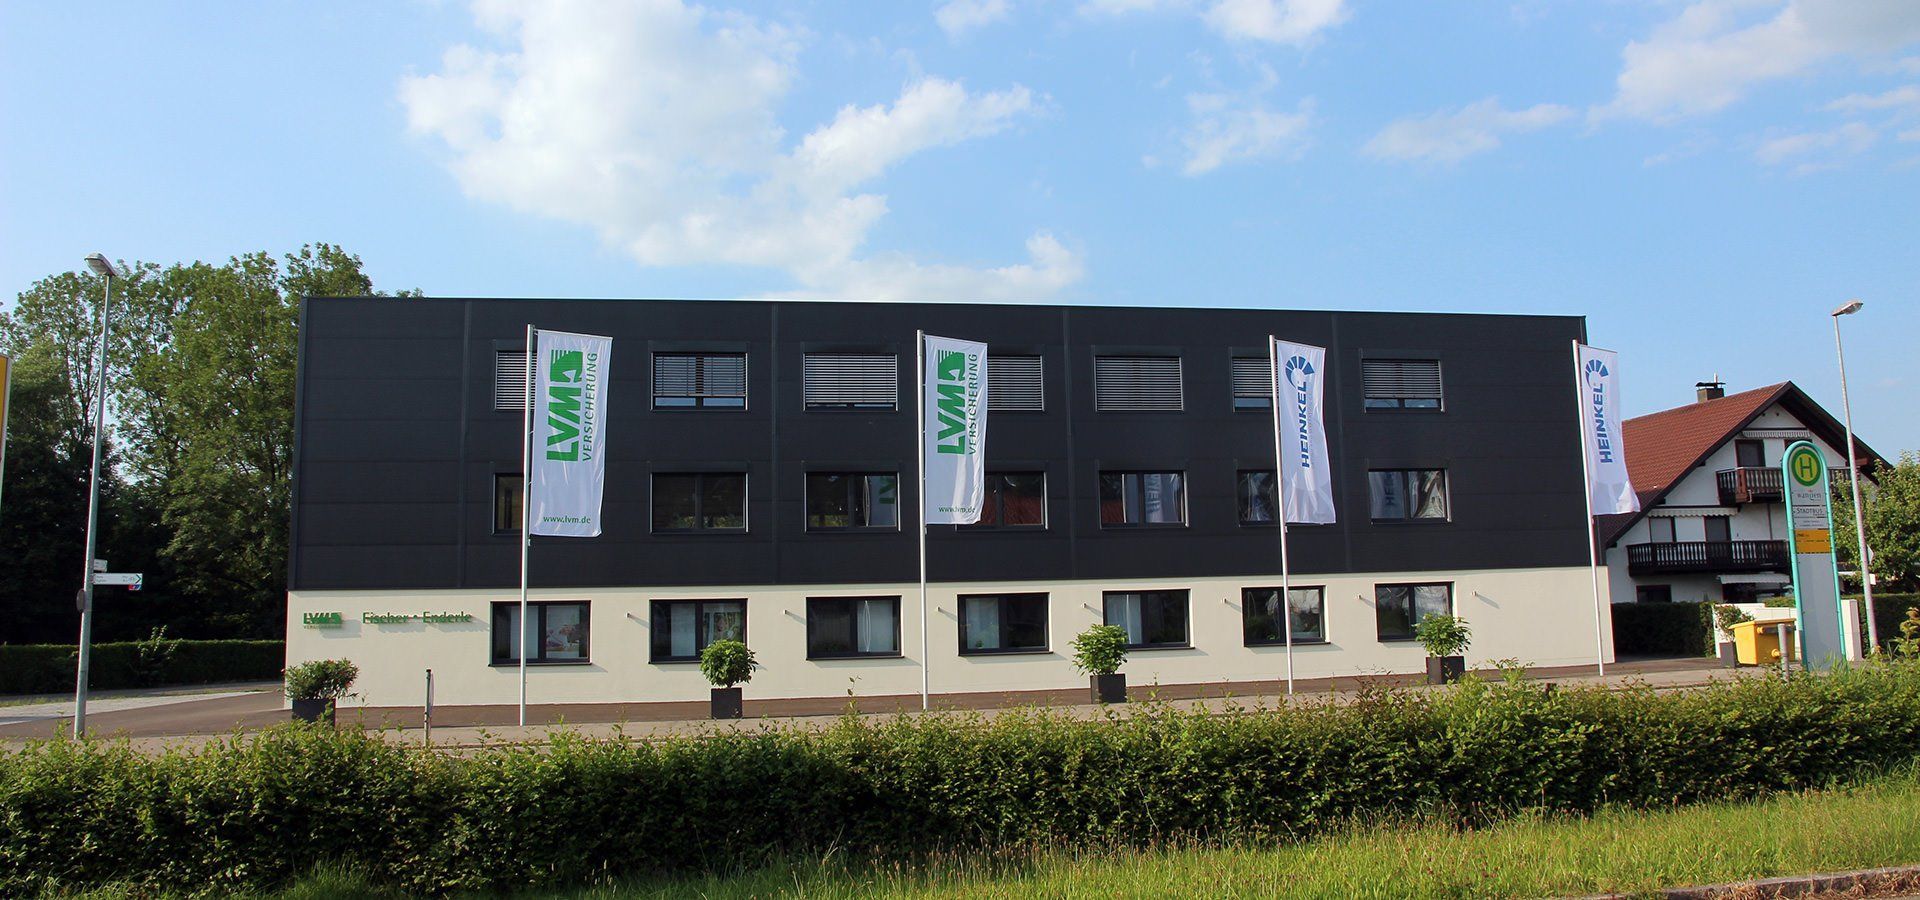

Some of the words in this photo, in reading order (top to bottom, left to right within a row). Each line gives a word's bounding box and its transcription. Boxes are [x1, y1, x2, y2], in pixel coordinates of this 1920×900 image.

[546, 386, 582, 462] LVM
[582, 352, 598, 462] VERSICHERUNG
[937, 383, 966, 455] LVM
[968, 354, 979, 455] VERSICHERUNG
[1297, 381, 1310, 468] HEINKEL
[1593, 383, 1613, 463] HEINKEL
[1799, 456, 1813, 478] H
[543, 515, 591, 524] www.lvm.de
[362, 611, 408, 624] Fischer
[422, 611, 473, 623] Enderle
